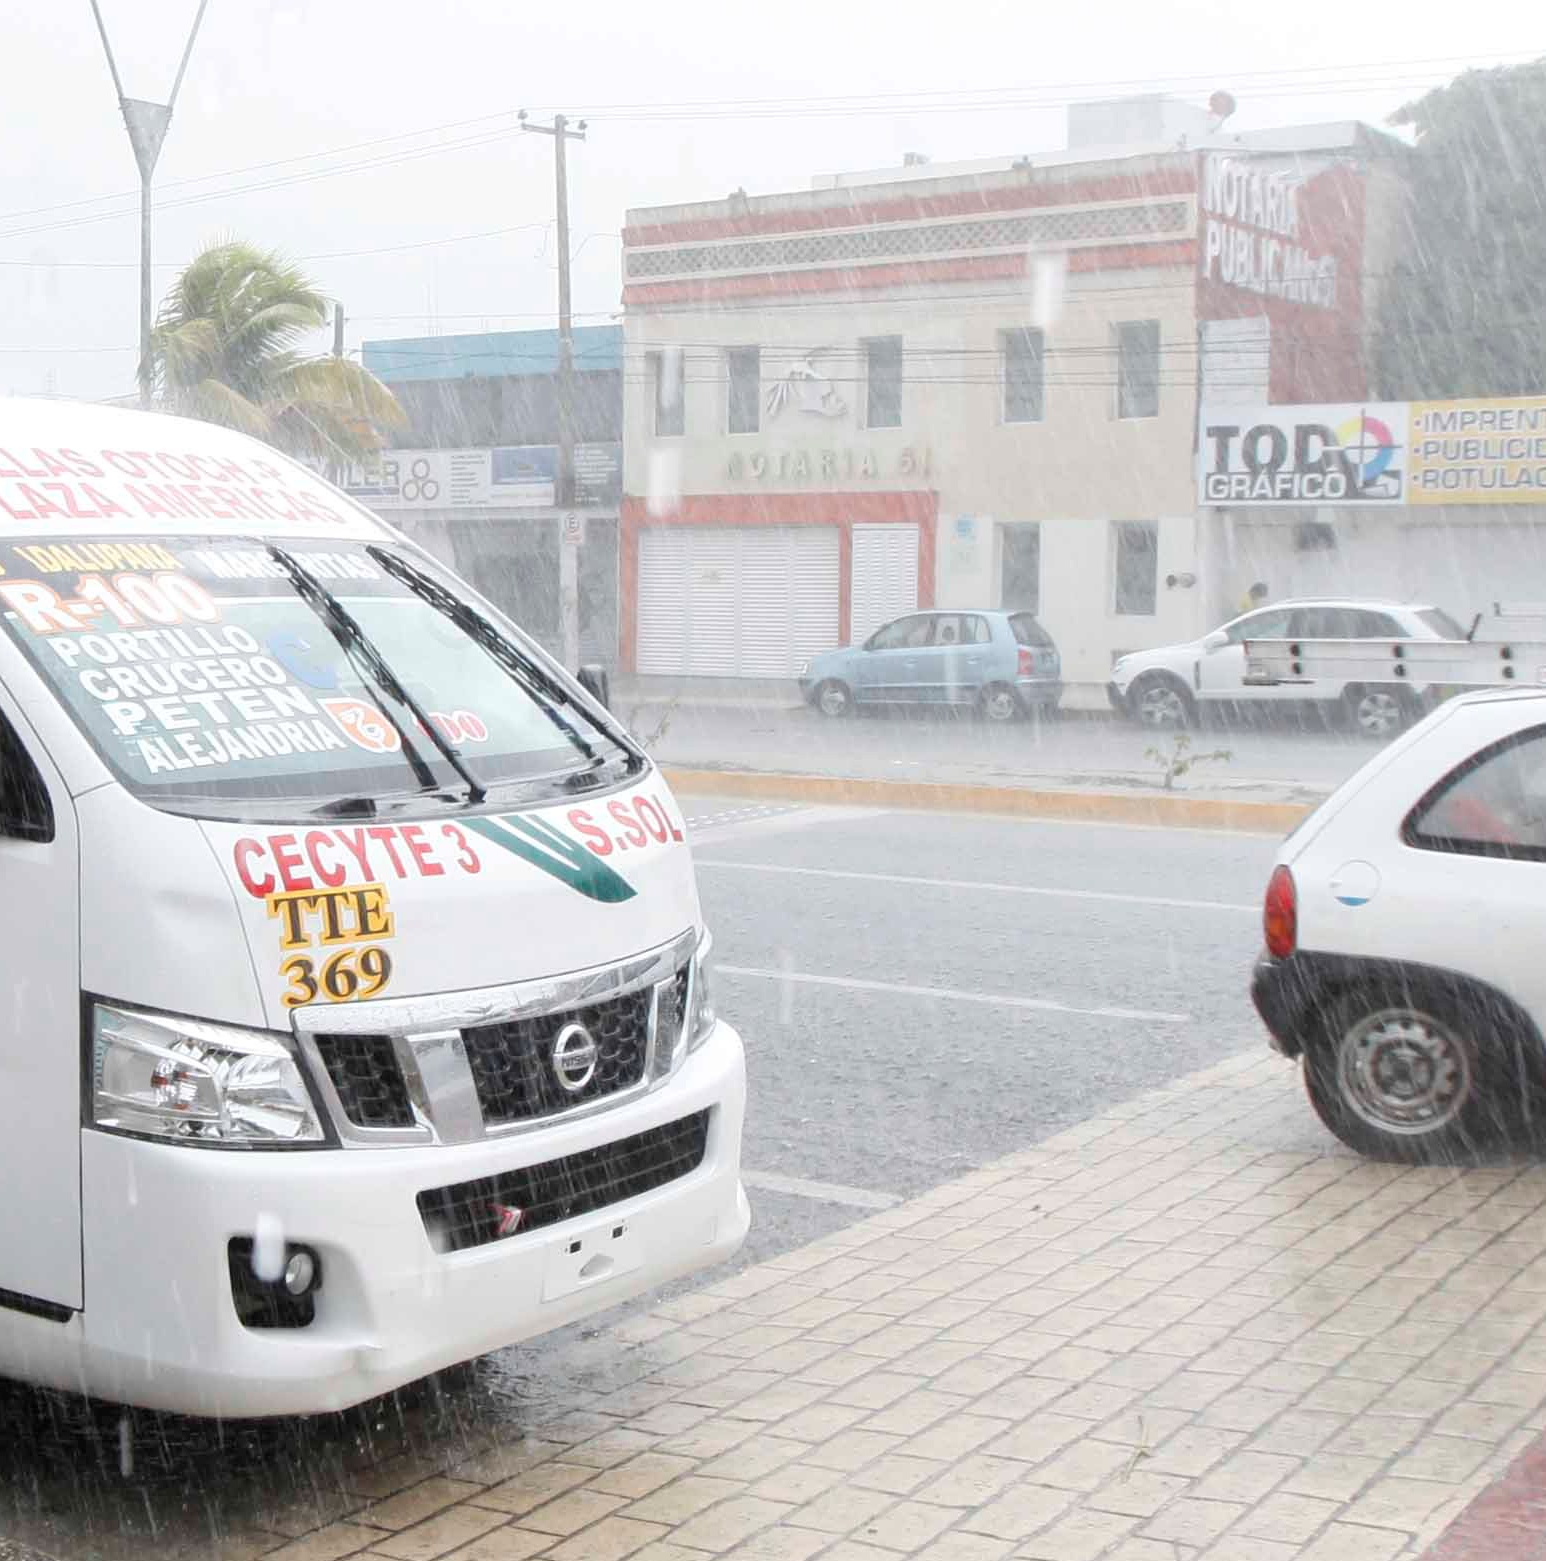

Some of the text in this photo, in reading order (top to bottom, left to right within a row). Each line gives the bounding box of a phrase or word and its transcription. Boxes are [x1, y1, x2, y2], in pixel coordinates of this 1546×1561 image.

[100, 450, 260, 485] OTOCH
[123, 482, 347, 525] AMERICAS
[46, 624, 261, 668] PORTILLO
[78, 655, 288, 701] CRUCERO
[102, 685, 320, 736] PETEN
[136, 719, 349, 774] ALEJANDRIA
[566, 793, 684, 857] S.SOL
[233, 823, 482, 900] CECYTE 3
[267, 884, 394, 949] TTE
[284, 946, 394, 1007] 369
